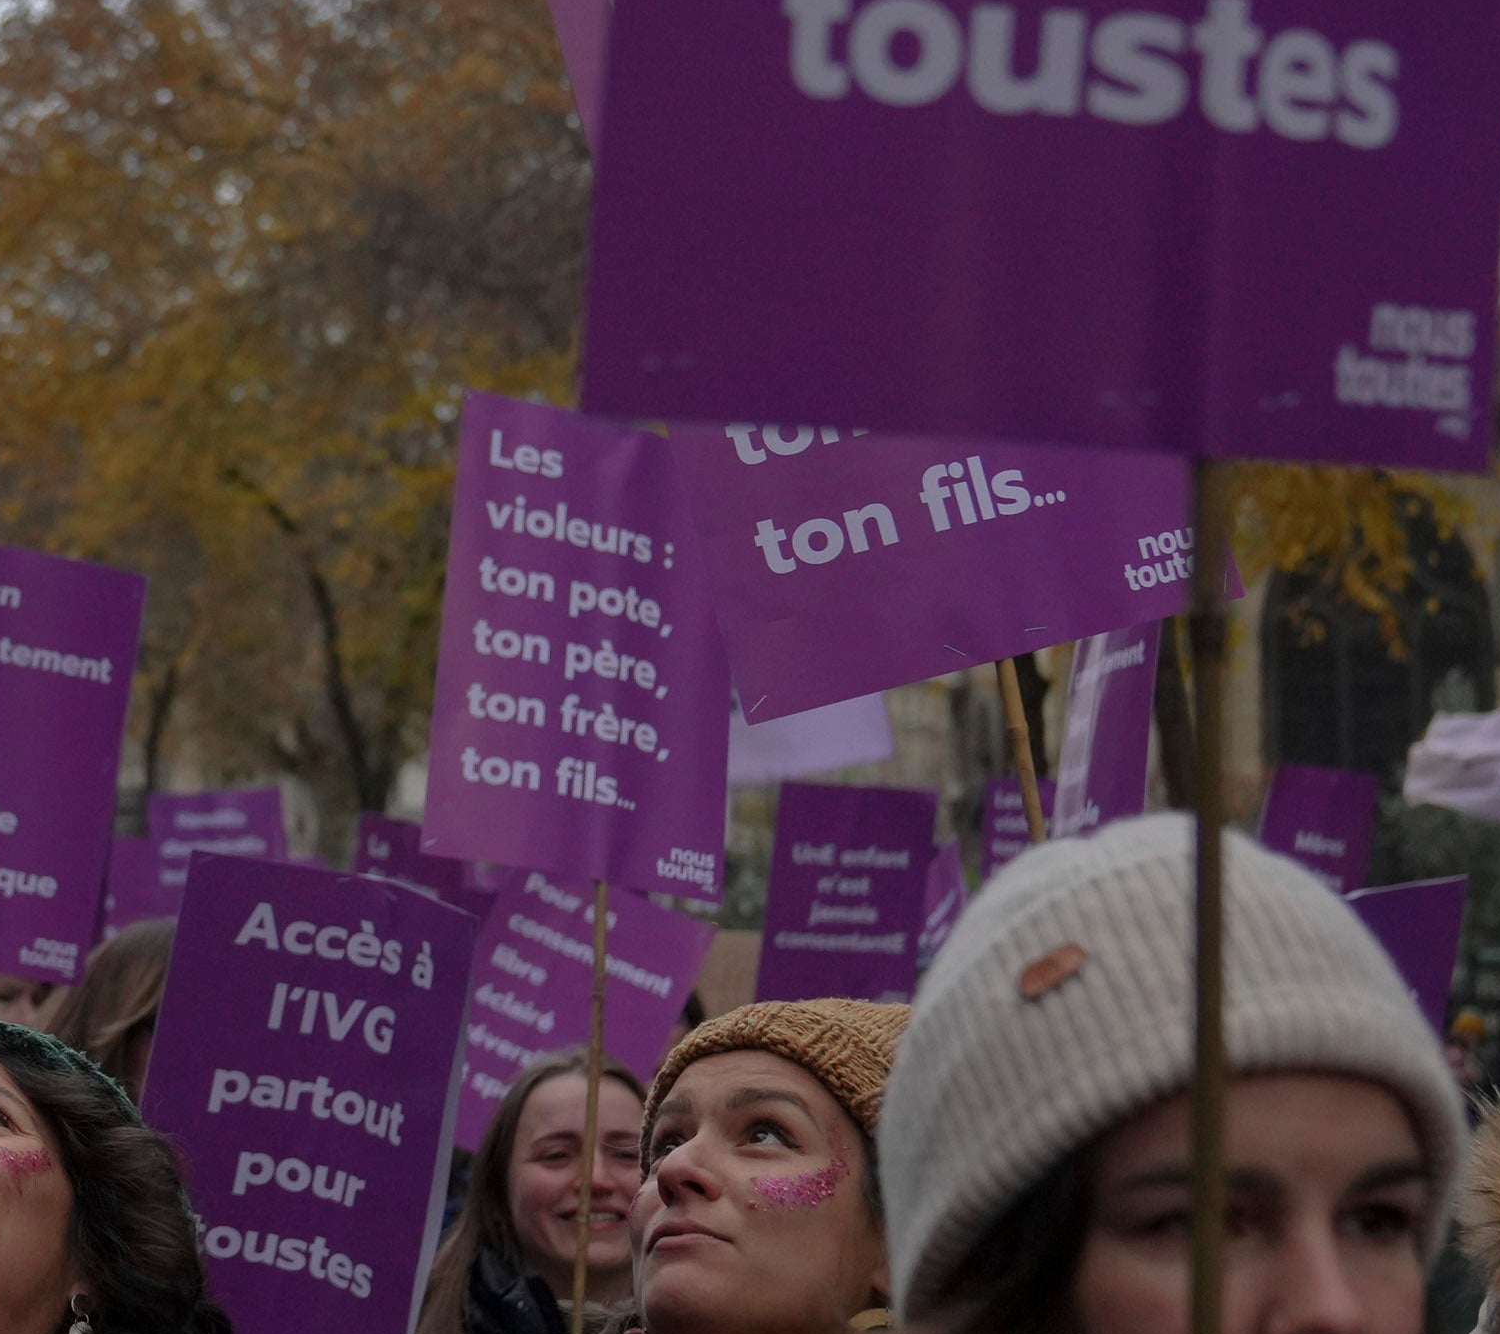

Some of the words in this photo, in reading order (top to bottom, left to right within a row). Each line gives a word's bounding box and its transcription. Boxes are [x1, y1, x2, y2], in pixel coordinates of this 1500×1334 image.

[487, 428, 564, 480] Les
[724, 421, 870, 465] to
[486, 495, 653, 565] violeurs
[753, 500, 899, 576] ton
[918, 455, 1067, 534] fils...
[1138, 527, 1194, 560] nou
[478, 554, 557, 605] ton
[568, 577, 674, 638] pote,
[1124, 552, 1194, 591] tout
[472, 618, 552, 667] ton
[563, 633, 670, 700] père,
[466, 681, 546, 730] ton
[561, 692, 671, 763] frère,
[460, 744, 541, 793] ton
[555, 757, 637, 811] fils...
[656, 857, 714, 884] toutes
[670, 847, 715, 869] nous
[524, 872, 582, 913] Pour
[234, 901, 402, 975] Accès
[411, 940, 434, 989] à
[266, 983, 397, 1055] l'IVG
[207, 1067, 404, 1145] partout
[231, 1149, 366, 1208] pour
